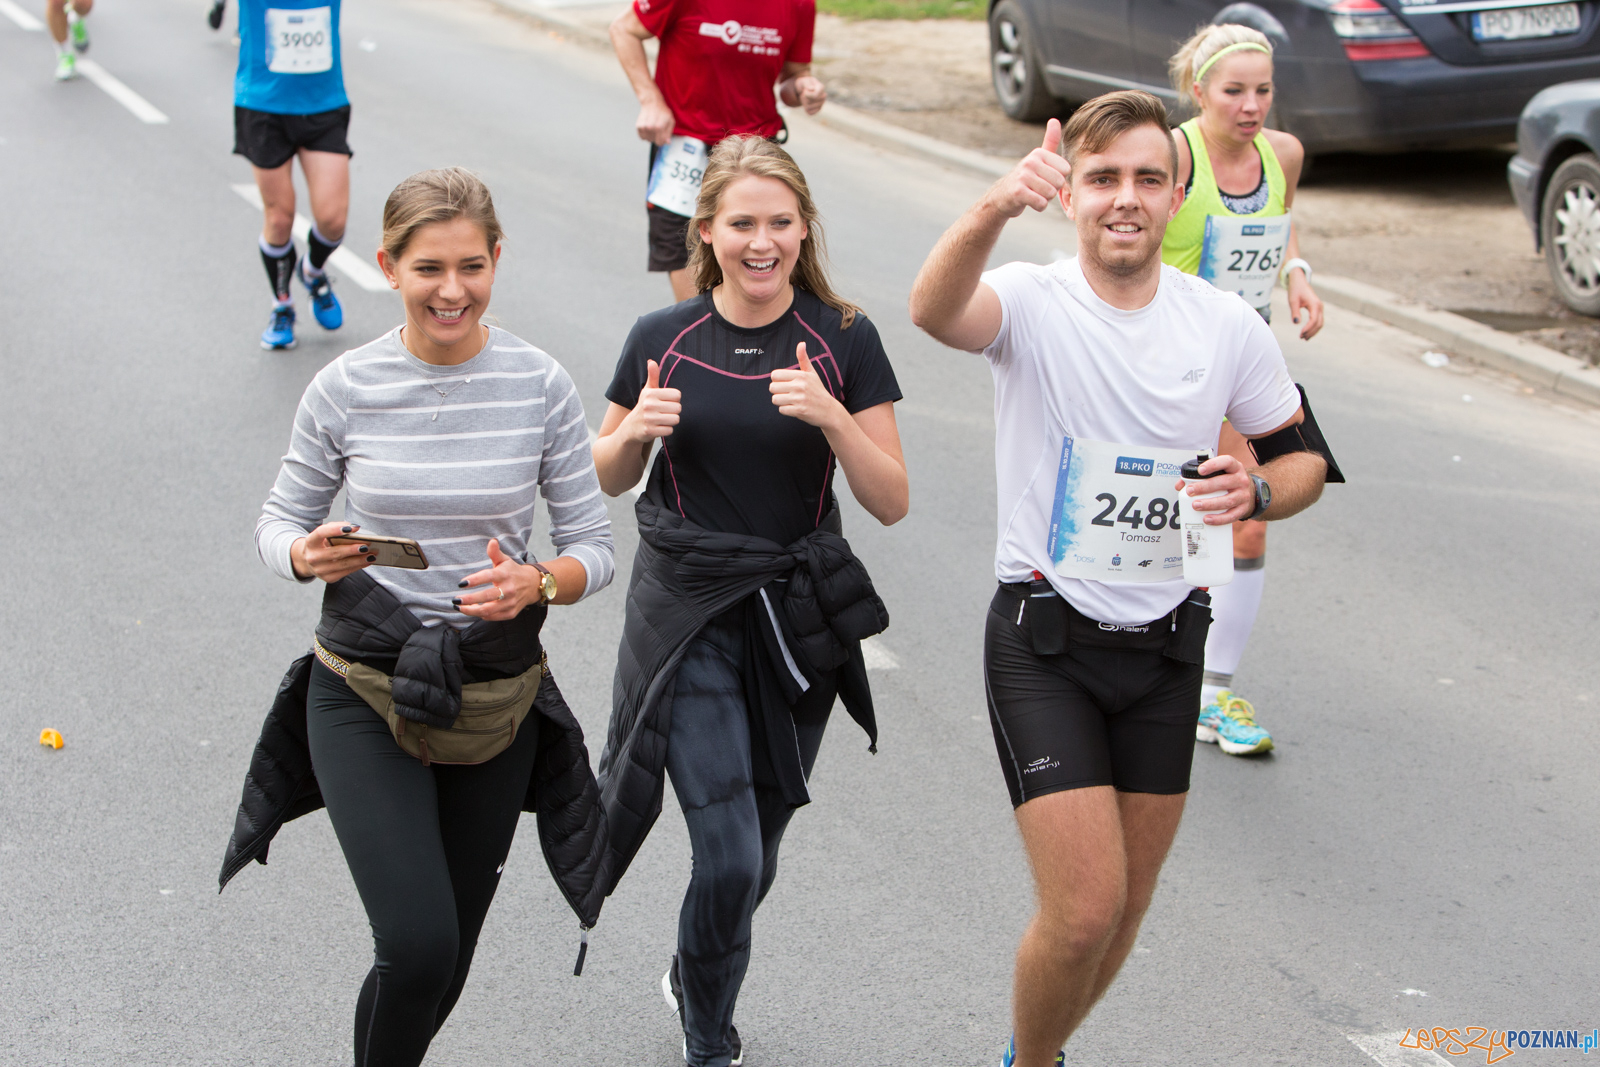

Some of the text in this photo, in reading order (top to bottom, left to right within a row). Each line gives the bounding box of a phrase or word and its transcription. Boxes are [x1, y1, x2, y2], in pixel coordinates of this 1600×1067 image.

[1485, 12, 1513, 33] PO
[280, 30, 324, 47] 3900
[1227, 245, 1282, 272] 2763
[1182, 368, 1205, 383] 4F
[1119, 461, 1151, 472] 18. PKO
[1156, 462, 1181, 470] POZna
[1119, 531, 1162, 543] Tomasz
[1138, 559, 1153, 568] 4F
